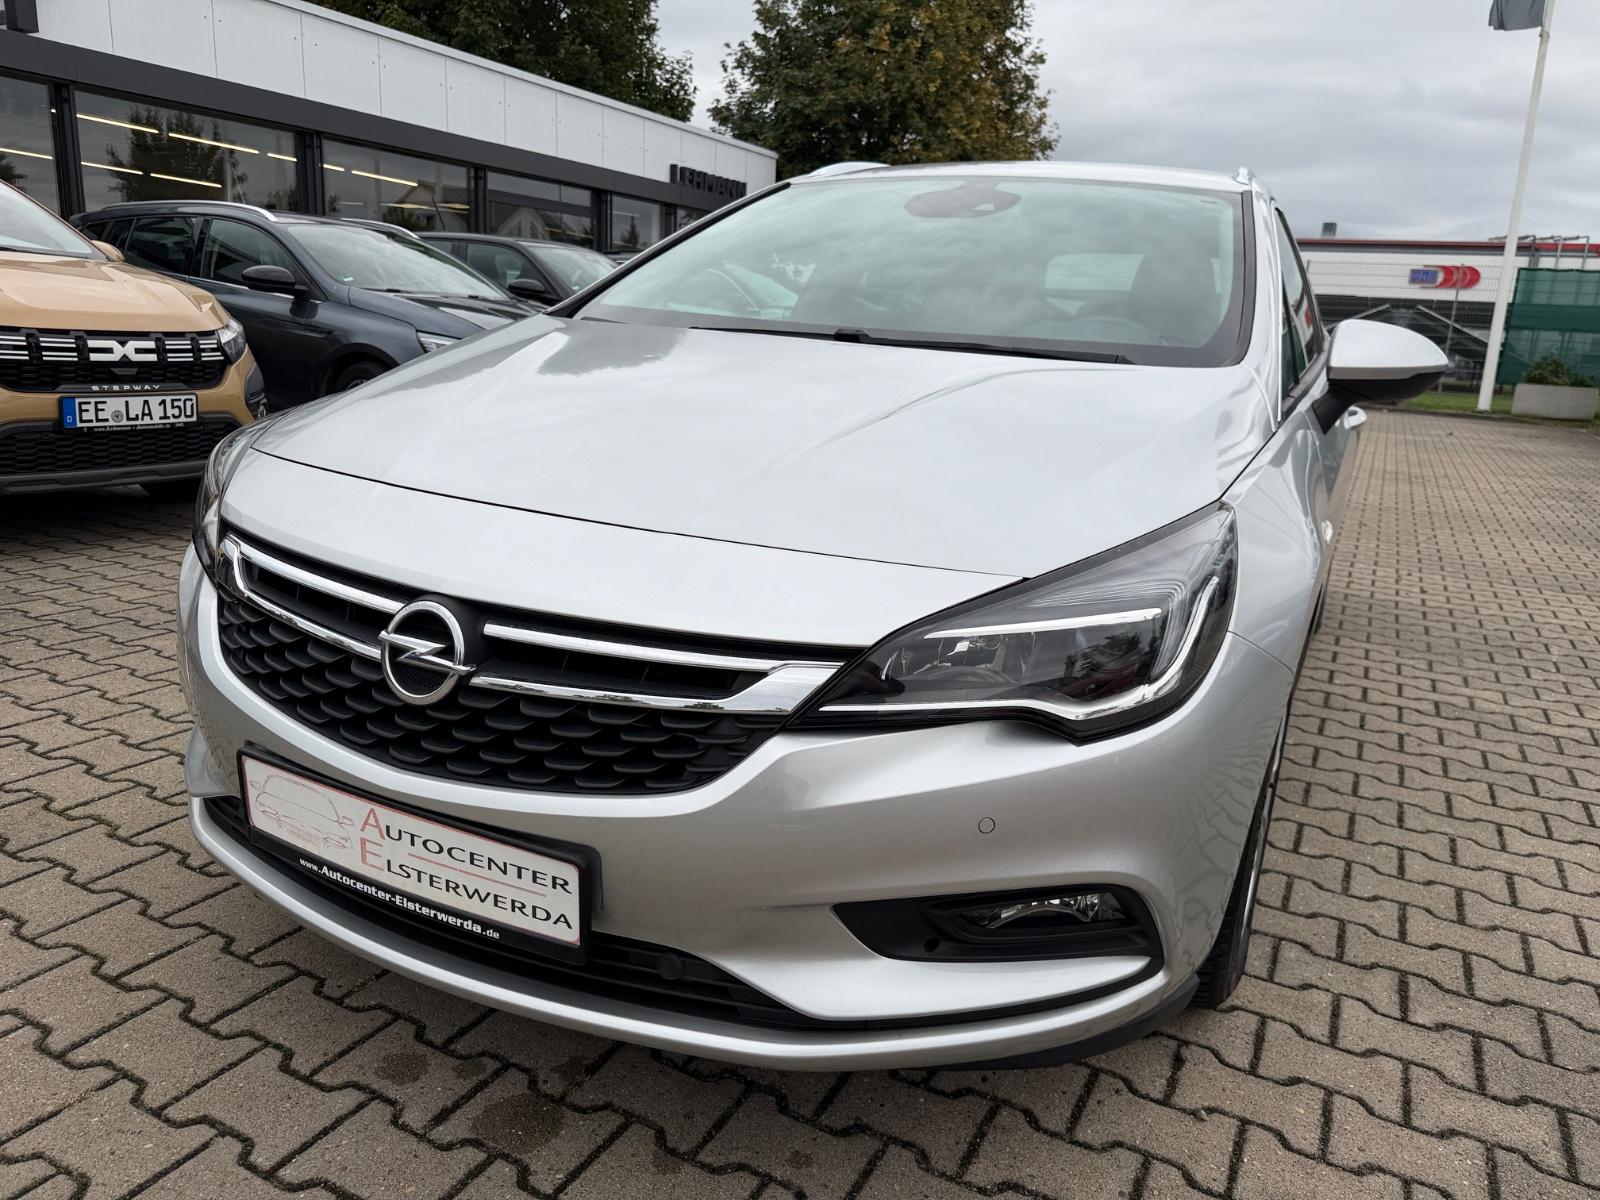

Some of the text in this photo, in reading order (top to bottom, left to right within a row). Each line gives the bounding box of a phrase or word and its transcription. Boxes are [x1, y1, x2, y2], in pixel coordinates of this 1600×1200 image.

[670, 164, 747, 199] LEHMANN
[78, 397, 194, 424] EE LA 150
[359, 807, 573, 895] AUTOCENTER
[359, 836, 574, 930] ELSTERWERDA
[299, 856, 500, 940] www.Autocenter-Elsterwerda.de
